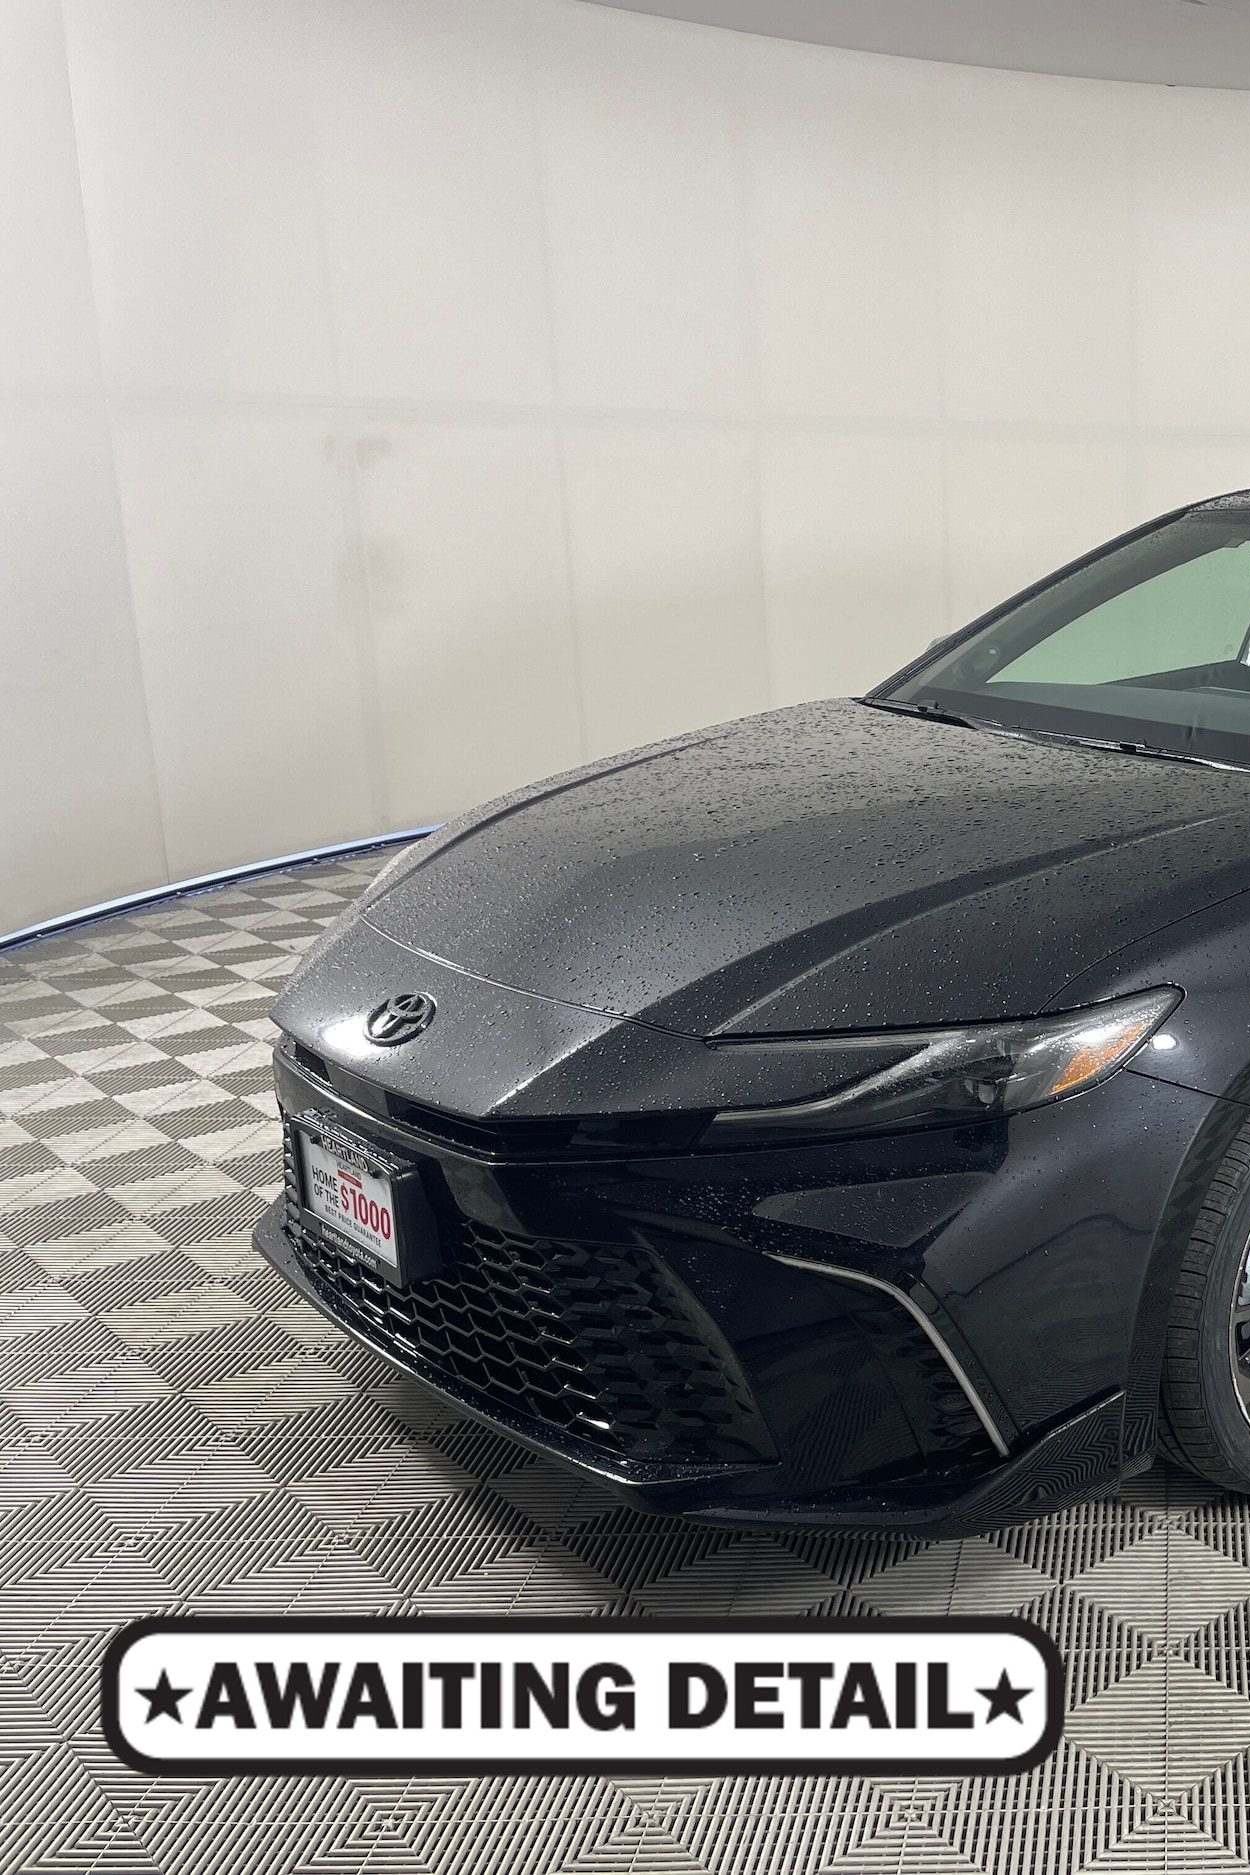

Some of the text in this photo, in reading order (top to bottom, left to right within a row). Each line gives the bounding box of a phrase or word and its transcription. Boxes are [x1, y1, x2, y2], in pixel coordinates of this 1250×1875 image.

[320, 1134, 369, 1173] HEARTLAND
[311, 1165, 339, 1192] HOME
[313, 1183, 339, 1208] OF THE
[324, 1204, 382, 1248] BEST PRICE GUARANTEE
[340, 1182, 391, 1240] $1000
